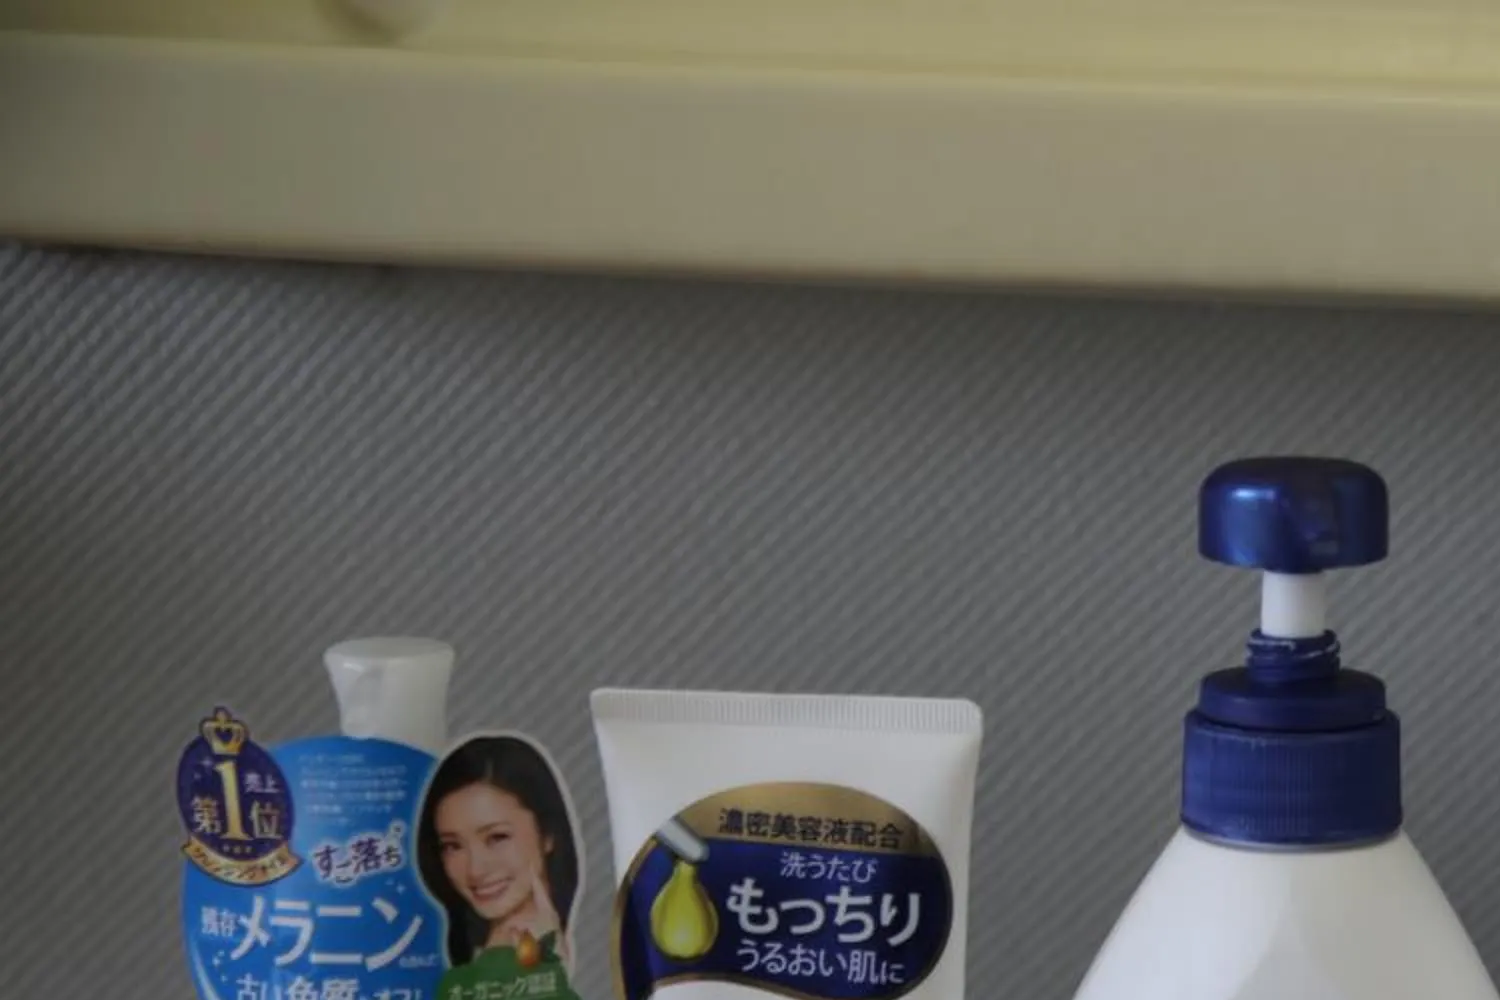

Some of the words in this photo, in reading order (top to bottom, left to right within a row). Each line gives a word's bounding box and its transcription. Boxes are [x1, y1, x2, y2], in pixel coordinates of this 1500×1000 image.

[781, 850, 877, 884] 洗うたび
[726, 876, 922, 947] もっちり
[736, 938, 905, 986] うるおい肌に
